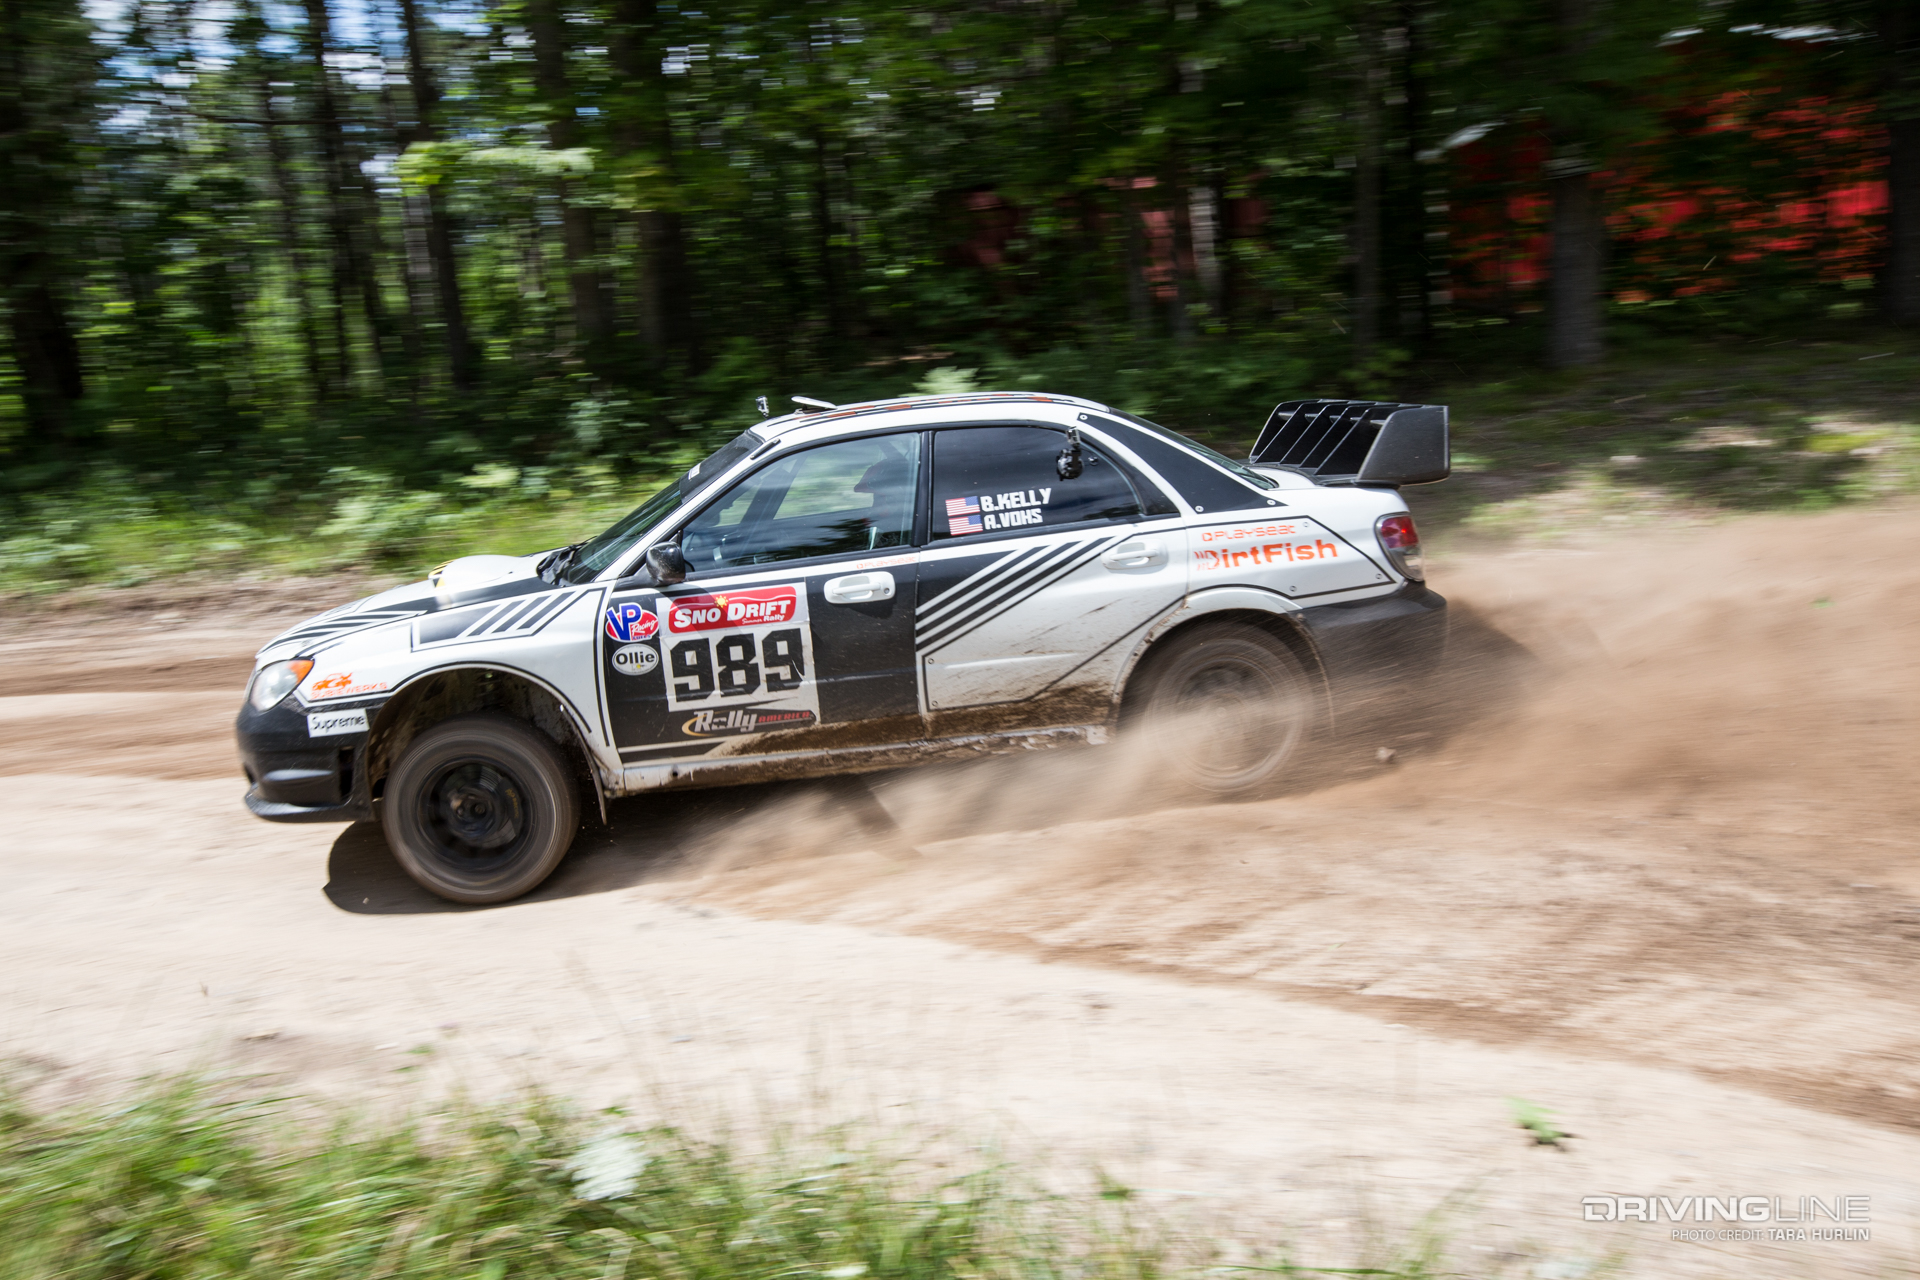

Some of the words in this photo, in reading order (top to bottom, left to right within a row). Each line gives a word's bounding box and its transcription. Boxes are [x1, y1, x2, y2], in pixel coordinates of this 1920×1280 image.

[980, 487, 1052, 512] B.KELLY
[984, 508, 1043, 530] A.VOHS
[1195, 539, 1338, 570] DirtFish
[606, 604, 642, 641] VP
[673, 608, 722, 629] SNO
[727, 600, 791, 621] DRIFT
[763, 613, 785, 623] Rally
[631, 620, 658, 636] Racing
[616, 651, 655, 665] Ollie
[670, 628, 805, 703] 989
[312, 716, 365, 733] Supreme
[693, 709, 757, 732] Rally
[758, 711, 810, 723] AMERICA
